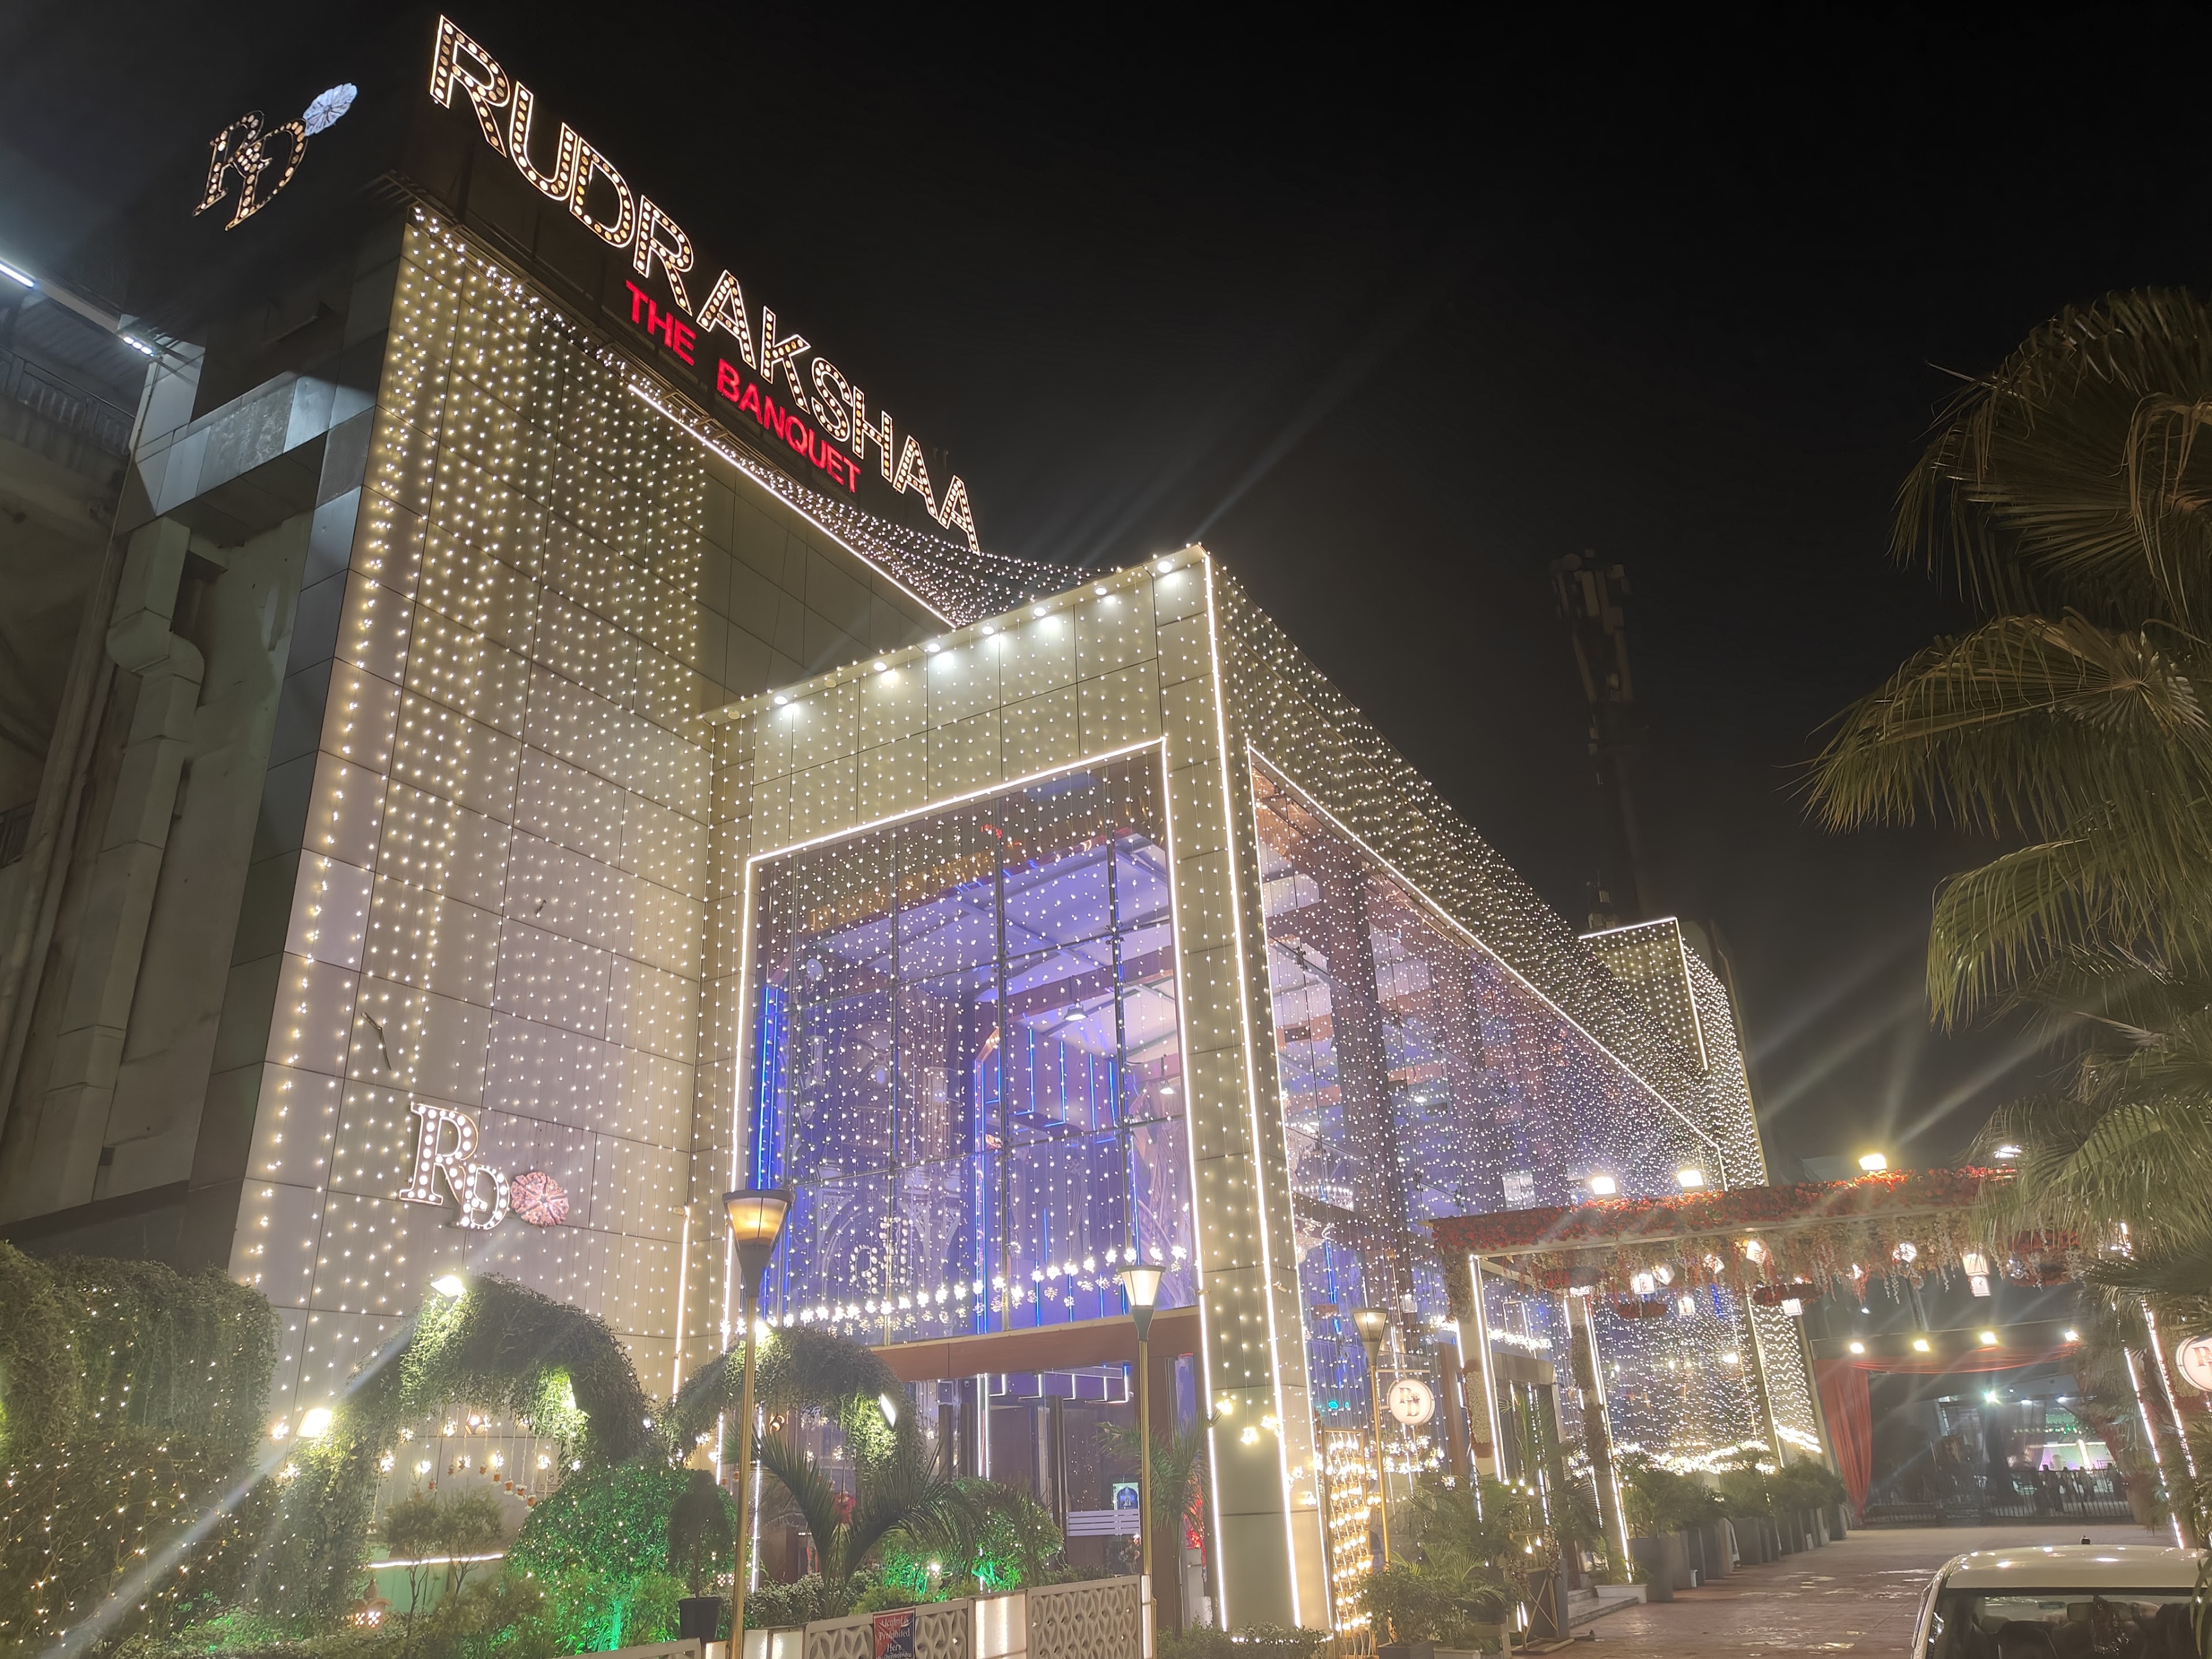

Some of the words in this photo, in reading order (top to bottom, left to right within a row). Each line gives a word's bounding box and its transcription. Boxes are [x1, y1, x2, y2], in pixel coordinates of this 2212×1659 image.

[429, 14, 980, 555] RUDRAKSHAA
[625, 279, 696, 366] THE
[716, 357, 861, 493] BANQUET
[878, 1627, 910, 1641] Prohibited
[887, 1642, 902, 1653] Here
